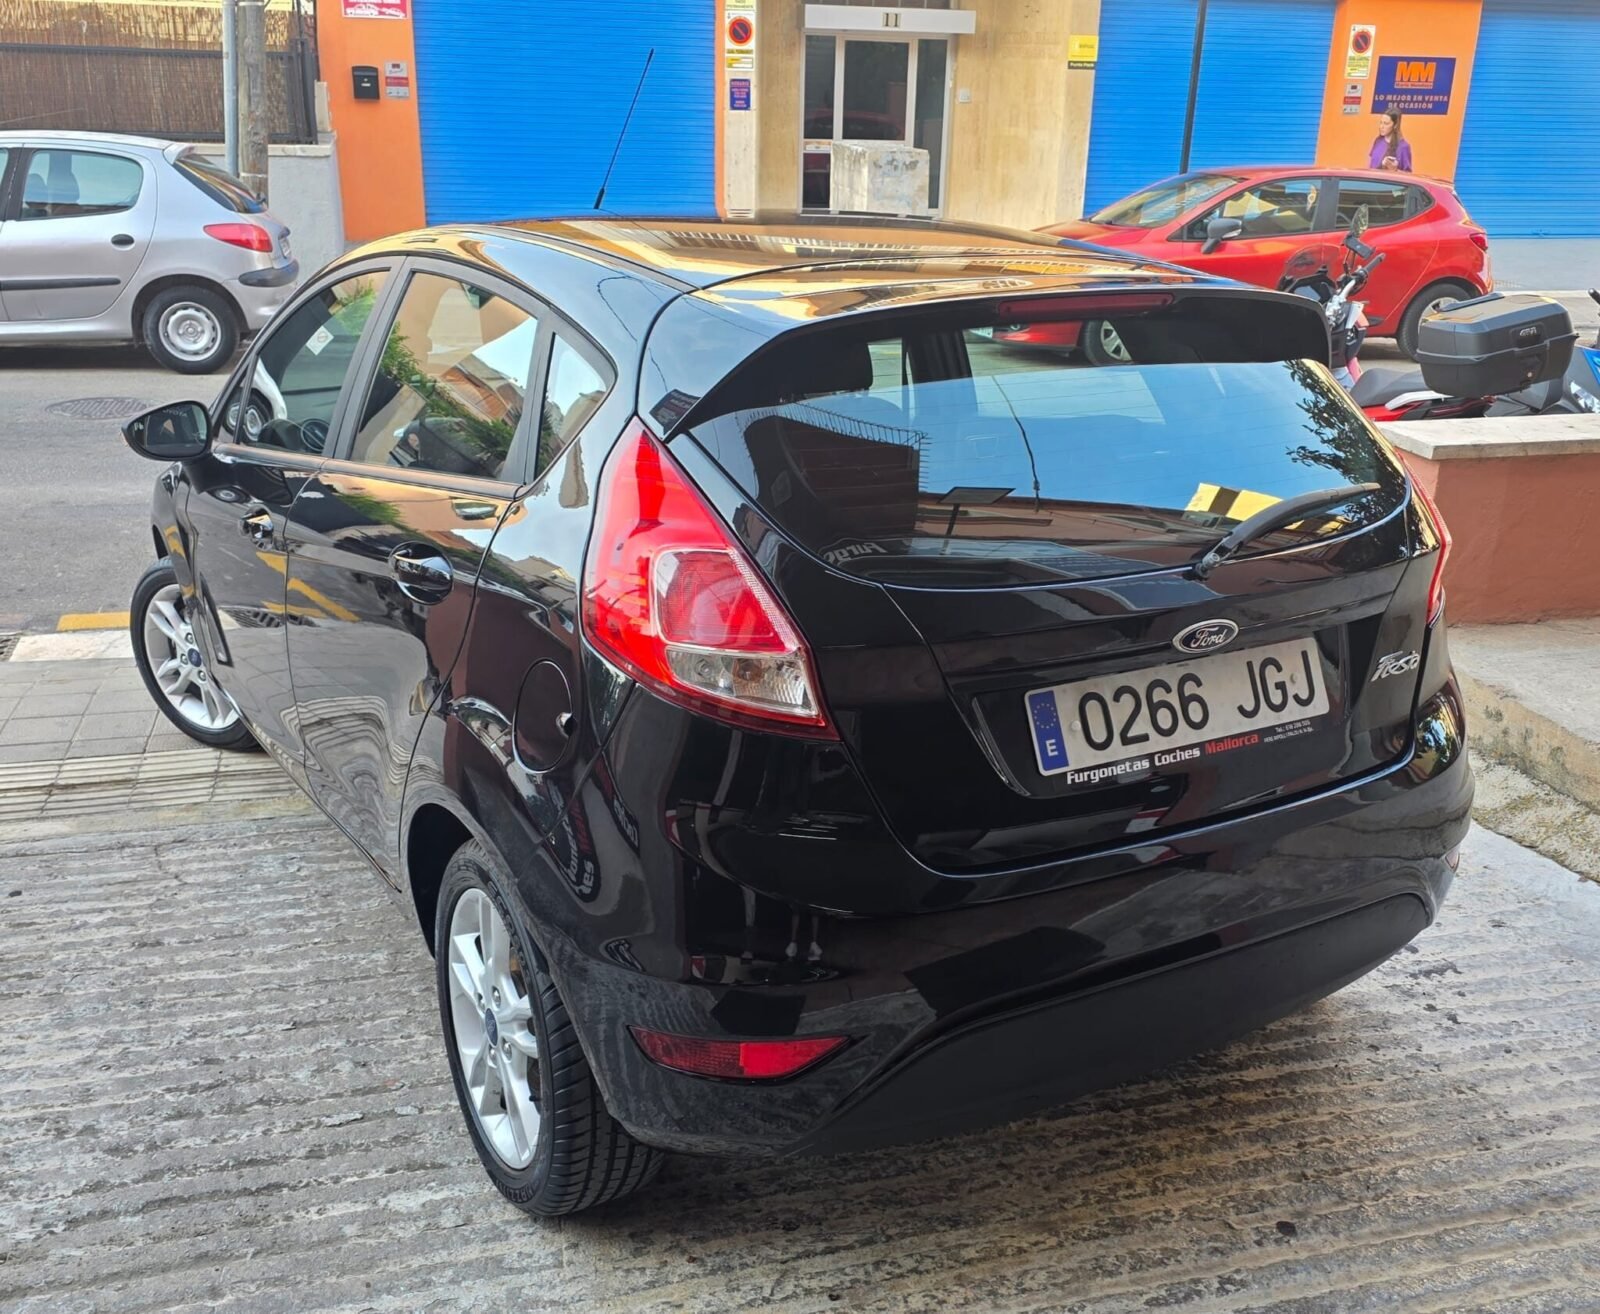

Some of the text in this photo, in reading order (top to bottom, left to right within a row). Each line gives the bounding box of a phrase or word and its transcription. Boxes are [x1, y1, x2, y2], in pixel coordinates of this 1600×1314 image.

[884, 12, 899, 27] 11
[1395, 62, 1437, 81] MM
[1190, 626, 1227, 648] Ford
[1078, 649, 1316, 752] 0266 JGJ
[1045, 739, 1059, 757] E
[1066, 732, 1260, 785] Furgonetas Coches Mallorca
